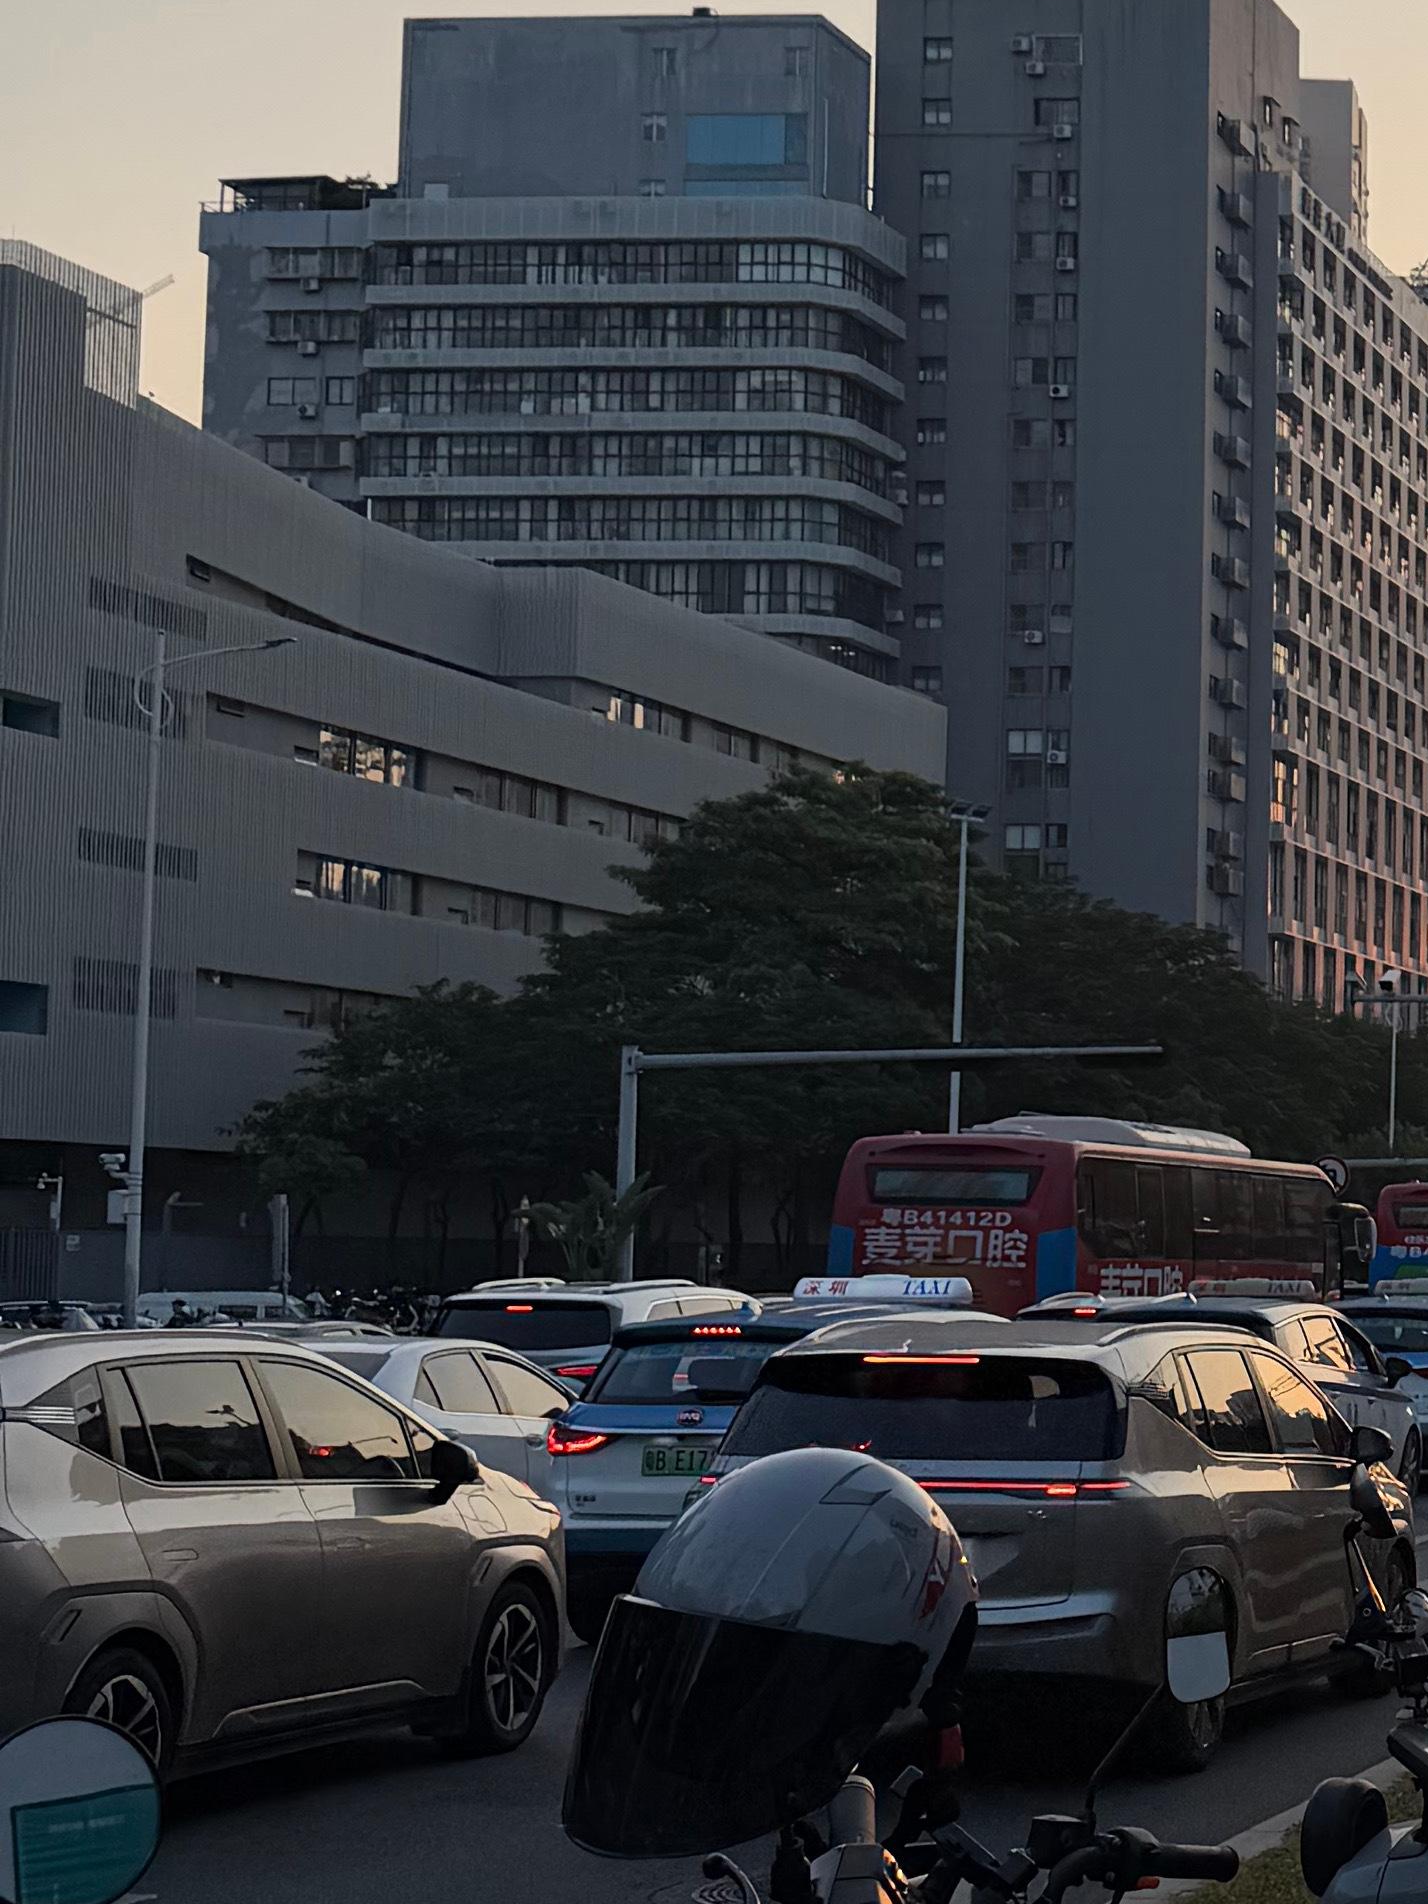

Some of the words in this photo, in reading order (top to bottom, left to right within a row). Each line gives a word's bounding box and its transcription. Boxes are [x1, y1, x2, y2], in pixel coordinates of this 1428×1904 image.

[881, 1208, 1012, 1227] 粤B41412D
[861, 1226, 1029, 1268] 麦芽口腔
[803, 1280, 849, 1295] 深圳
[902, 1280, 952, 1295] TAXI
[1266, 1280, 1303, 1294] TAXI
